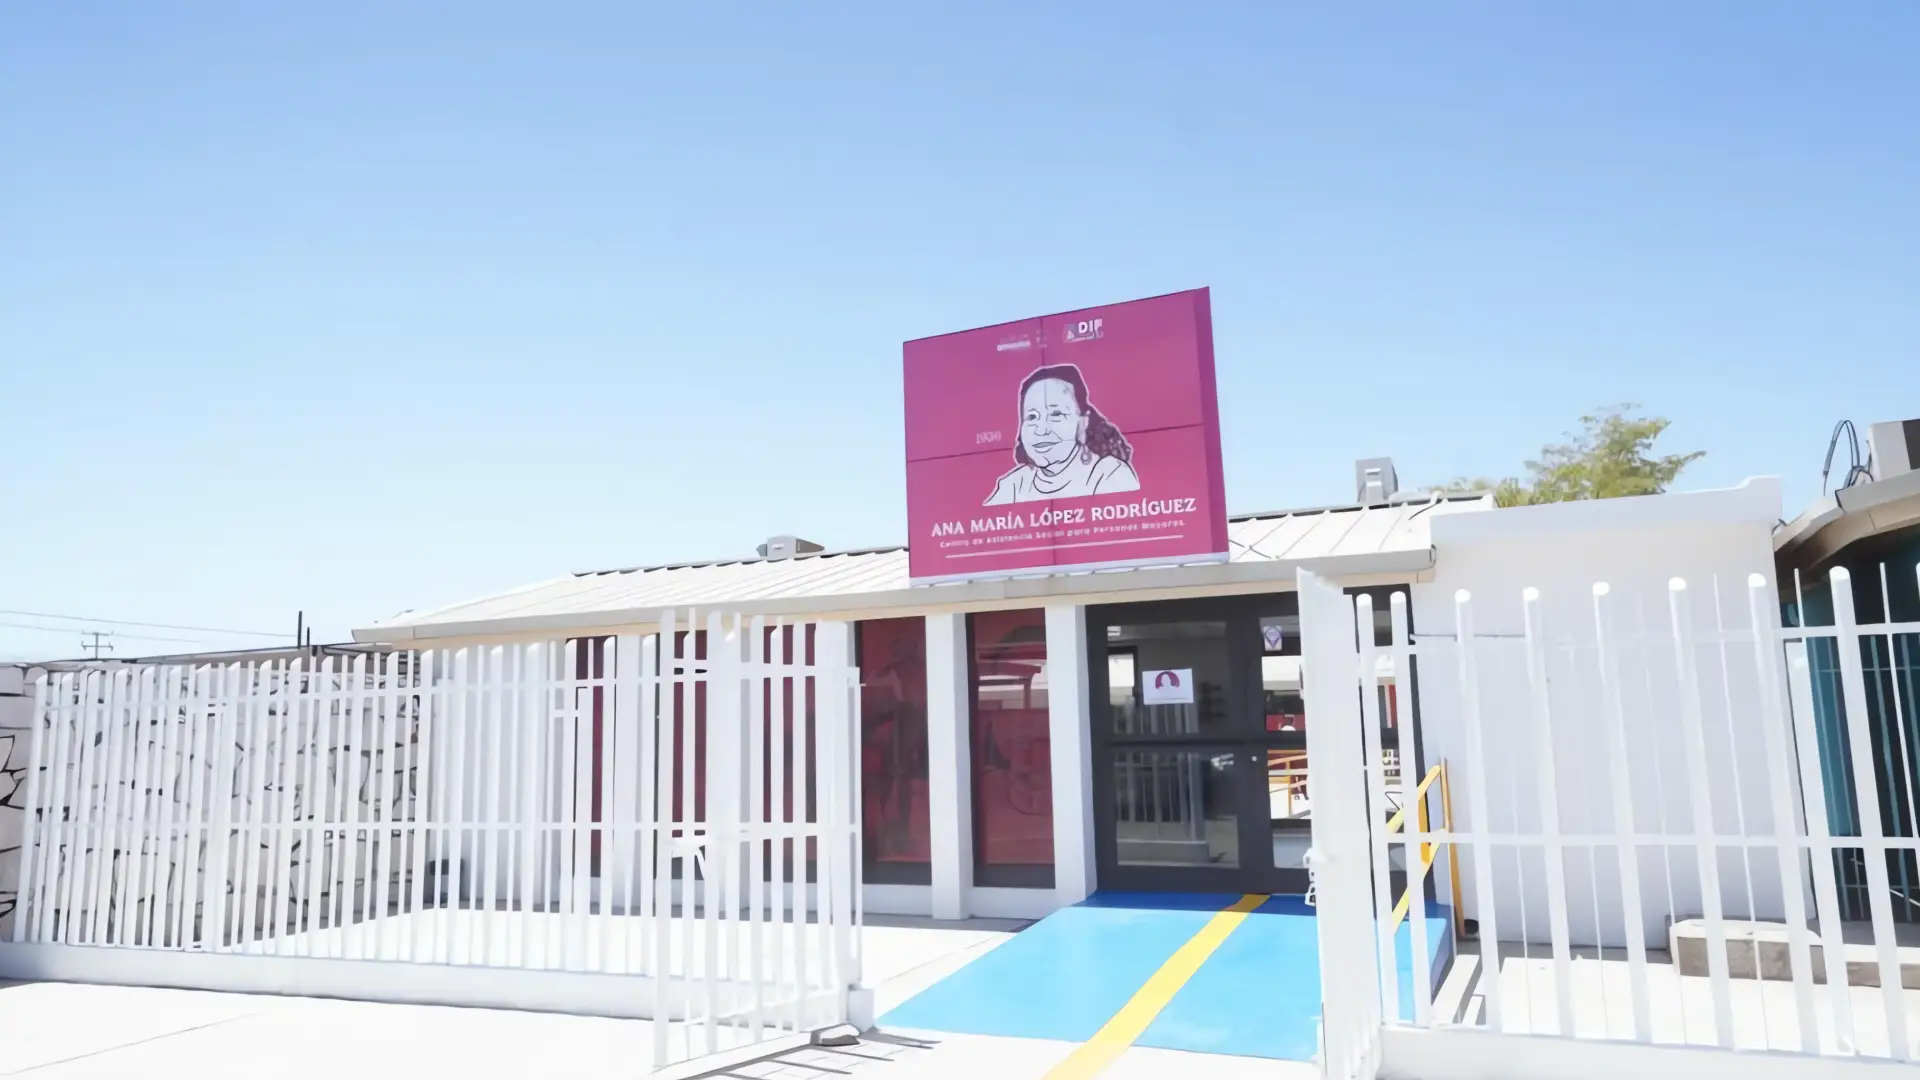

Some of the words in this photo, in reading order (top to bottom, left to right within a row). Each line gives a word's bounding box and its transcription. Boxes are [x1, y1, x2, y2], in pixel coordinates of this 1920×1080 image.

[931, 520, 965, 537] ANA
[970, 511, 1025, 533] MARÍA
[1029, 507, 1085, 527] LÓPEZ
[1091, 498, 1197, 521] RODRÍGUEZ
